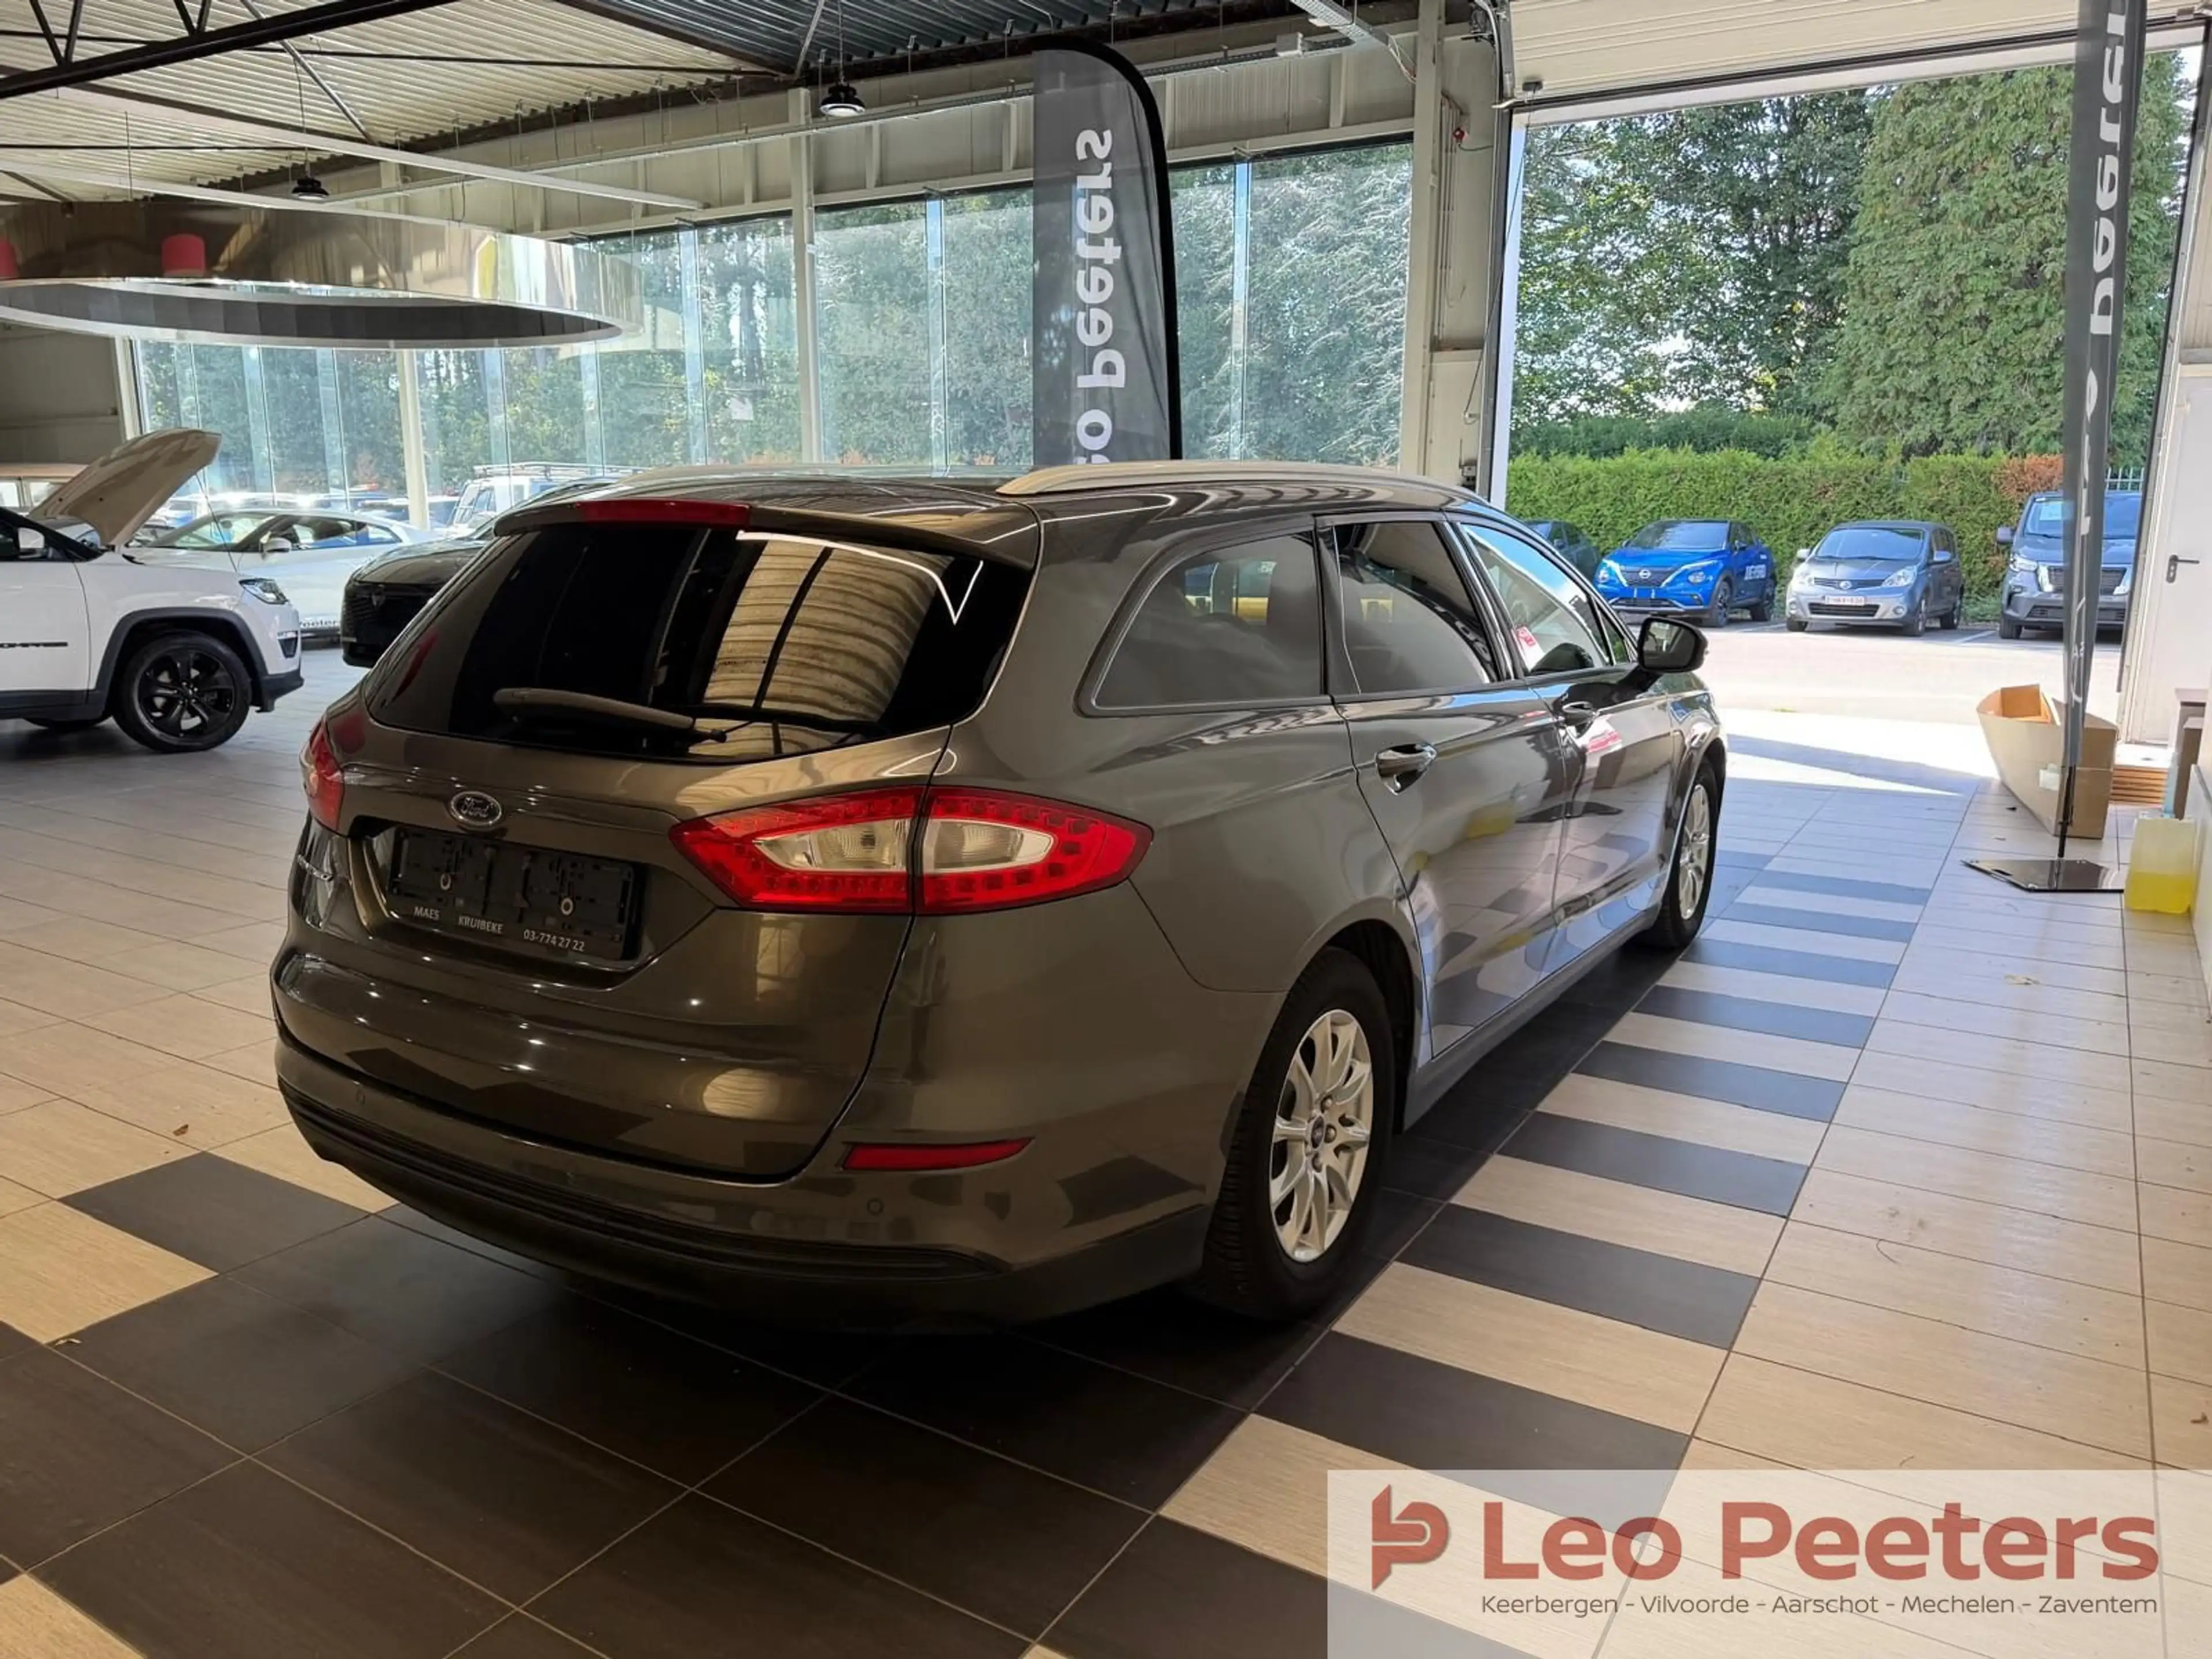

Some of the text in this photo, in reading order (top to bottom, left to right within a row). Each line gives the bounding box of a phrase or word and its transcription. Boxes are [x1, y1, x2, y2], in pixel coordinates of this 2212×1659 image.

[414, 906, 440, 921] MAES
[459, 914, 504, 934] KRUIBEKE
[558, 937, 571, 949] 27
[572, 940, 586, 952] 22
